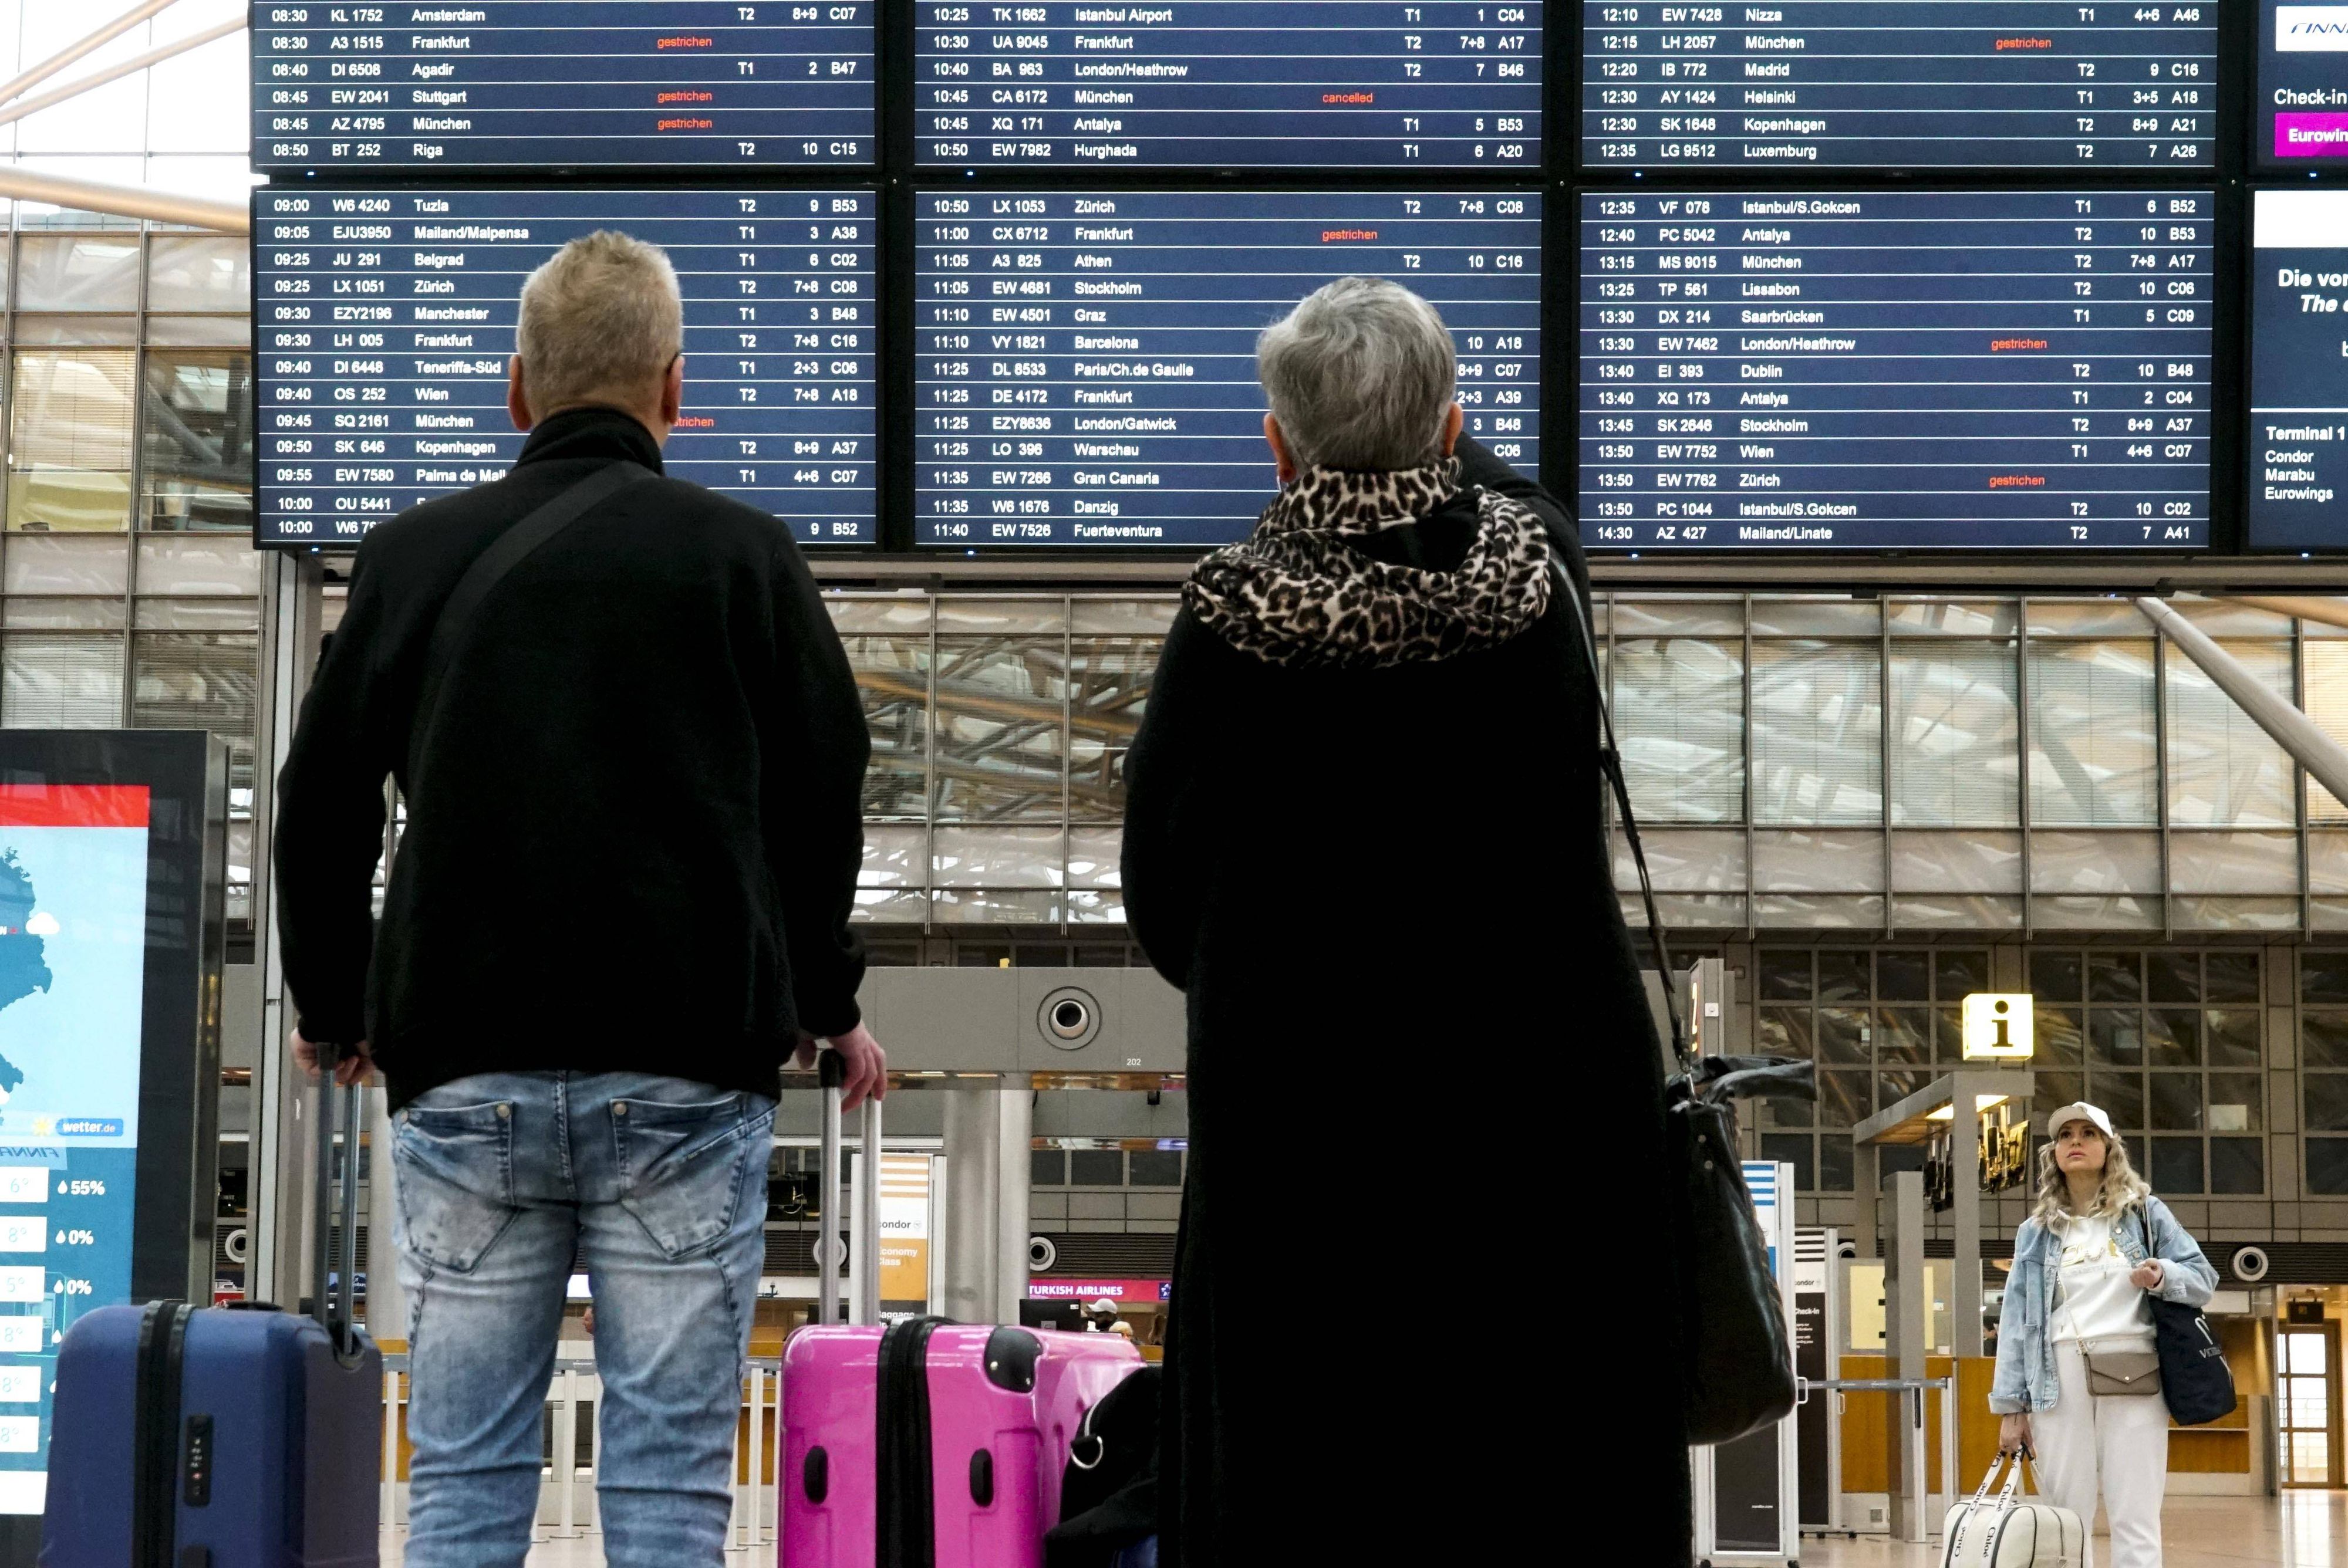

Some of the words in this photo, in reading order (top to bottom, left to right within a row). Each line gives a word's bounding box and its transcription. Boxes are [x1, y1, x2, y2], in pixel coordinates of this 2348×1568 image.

[272, 9, 308, 22] 08:30
[331, 9, 349, 22] KL
[352, 9, 383, 22] 1752
[411, 8, 485, 22] Amsterdam
[737, 7, 754, 21] T2
[792, 7, 818, 20] 8+9
[829, 7, 856, 20] C07
[934, 8, 969, 21] 10:25
[992, 8, 1012, 21] TK
[1015, 8, 1046, 21] 1662
[1075, 8, 1125, 22] Istanbul
[1128, 8, 1172, 25] Airport
[1405, 8, 1420, 22] T1
[1478, 8, 1484, 22] 1
[1497, 8, 1525, 22] C04
[1603, 8, 1638, 22] 12:10
[1662, 8, 1687, 22] EW
[1690, 8, 1722, 22] 7428
[1746, 8, 1782, 22] Nizza
[2078, 8, 2094, 22] T1
[2134, 8, 2160, 22] 4+6
[2173, 8, 2199, 21] A46
[2290, 23, 2348, 34] FINN
[1602, 63, 1637, 76] 12:20
[1662, 63, 1676, 76] IB
[1683, 63, 1707, 76] 772
[1745, 63, 1790, 76] Madrid
[2077, 63, 2095, 77] T2
[2150, 63, 2159, 76] 9
[2171, 63, 2199, 76] C16
[272, 90, 308, 103] 08:45
[332, 90, 356, 103] EW
[358, 90, 389, 103] 2041
[413, 90, 467, 106] Stuttgart
[657, 90, 711, 103] gestrichen
[933, 90, 969, 103] 10:45
[992, 90, 1013, 103] CA
[1016, 90, 1048, 103] 6172
[1075, 90, 1133, 103] München
[1323, 92, 1372, 103] cancelled
[2274, 88, 2347, 105] Check-in
[273, 144, 309, 156] 08:50
[332, 143, 350, 156] BT
[357, 143, 381, 156] 252
[413, 143, 443, 159] Riga
[738, 142, 755, 156] T2
[802, 142, 818, 155] 10
[830, 142, 857, 156] C15
[935, 200, 969, 213] 10:50
[993, 200, 1011, 213] LX
[1015, 200, 1046, 213] 1053
[1074, 200, 1115, 213] Zürich
[1404, 200, 1421, 214] T2
[1459, 200, 1484, 214] 7+8
[1496, 201, 1523, 214] C08
[274, 226, 310, 239] 09:05
[333, 226, 392, 239] EJU3950
[414, 226, 529, 242] Mailand/Malpensa
[739, 226, 754, 239] T1
[810, 226, 819, 239] 3
[831, 226, 858, 239] A38
[1600, 228, 1635, 242] 12:40
[1659, 228, 1680, 242] PC
[1683, 228, 1715, 242] 5042
[1742, 228, 1790, 244] Antalya
[2074, 227, 2092, 241] T2
[2140, 227, 2156, 241] 10
[2170, 227, 2195, 241] B53
[2279, 269, 2312, 287] Die
[2300, 294, 2338, 312] The
[275, 306, 311, 320] 09:30
[333, 306, 392, 320] EZY2196
[414, 306, 490, 320] Manchester
[739, 307, 755, 320] T1
[810, 307, 819, 320] 3
[832, 307, 858, 320] B48
[1599, 310, 1635, 323] 13:30
[1659, 310, 1679, 323] DX
[1686, 310, 1711, 323] 214
[1741, 310, 1824, 323] Saarbrücken
[2073, 309, 2089, 322] T1
[2146, 309, 2155, 322] 5
[2167, 309, 2194, 322] C09
[1599, 337, 1634, 351] 13:30
[1658, 337, 1684, 351] EW
[1686, 337, 1718, 351] 7462
[1741, 337, 1856, 350] London/Heathrow
[1991, 338, 2046, 351] gestrichen
[276, 387, 312, 400] 09:40
[334, 387, 356, 400] OS
[362, 387, 386, 401] 252
[414, 387, 449, 401] Wien
[739, 388, 757, 401] T2
[794, 388, 819, 401] 7+8
[831, 388, 858, 401] A18
[934, 389, 969, 403] 11:25
[993, 389, 1013, 403] DE
[1016, 390, 1048, 403] 4172
[1074, 390, 1133, 403] Frankfurt
[1495, 391, 1522, 404] A39
[2266, 426, 2333, 441] Terminal
[2338, 426, 2345, 441] 1
[1598, 445, 1634, 458] 13:50
[1657, 445, 1682, 458] EW
[1685, 445, 1717, 458] 7752
[1740, 445, 1774, 458] Wien
[2072, 444, 2087, 458] T1
[2127, 444, 2153, 458] 4+6
[2165, 444, 2192, 458] C07
[2265, 450, 2315, 463] Condor
[2265, 468, 2315, 481] Marabu
[2265, 486, 2333, 503] Eurowings
[934, 523, 969, 536] 11:40
[993, 523, 1017, 536] EW
[1019, 523, 1051, 537] 7526
[1074, 523, 1162, 537] Fuerteventura
[1598, 526, 1633, 539] 14:30
[1656, 526, 1676, 539] AZ
[1682, 526, 1707, 539] 427
[1739, 526, 1833, 539] Mailand/Linate
[2070, 526, 2087, 539] T2
[2143, 526, 2151, 539] 7
[2164, 526, 2189, 539] A41
[1126, 1058, 1142, 1066] 202
[62, 1121, 116, 1133] wetter.de
[71, 1180, 105, 1195] 55%
[879, 1219, 912, 1229] ondor
[68, 1230, 93, 1245] 0%
[880, 1247, 918, 1258] conomy
[66, 1279, 92, 1295] 0%
[1029, 1285, 1074, 1295] TURKISH
[1076, 1286, 1123, 1296] AIRLINES
